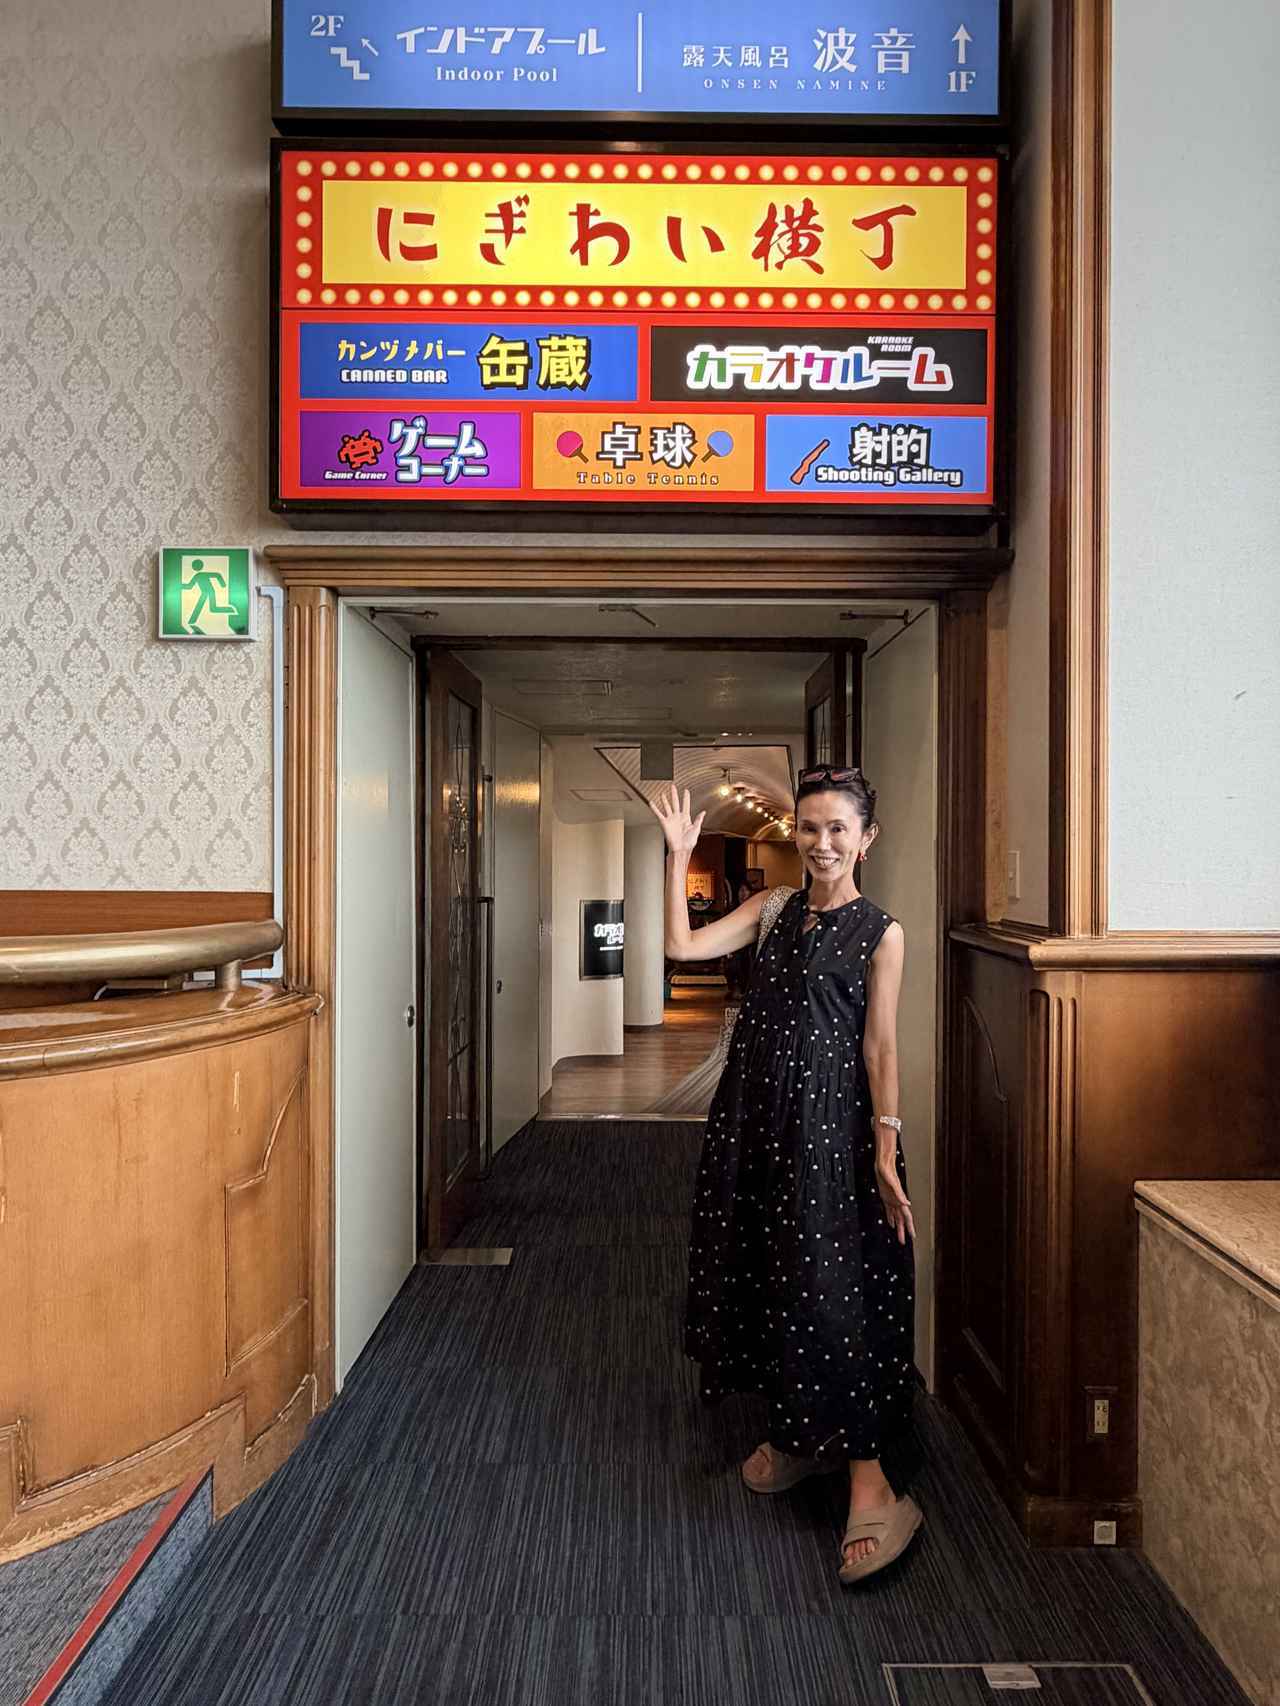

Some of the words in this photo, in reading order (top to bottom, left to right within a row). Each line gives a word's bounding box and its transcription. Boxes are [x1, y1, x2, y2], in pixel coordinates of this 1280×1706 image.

[310, 15, 344, 37] 2F
[396, 26, 606, 55] インドアプール
[682, 44, 790, 68] 露天風呂
[812, 27, 916, 74] 波音
[435, 66, 504, 82] Indoor
[513, 67, 558, 83] Pool
[703, 78, 779, 90] ONSEN
[796, 79, 888, 91] NAMINE
[947, 71, 976, 93] 1F
[376, 194, 917, 275] にぎわい横丁
[867, 335, 914, 345] KARAOKE
[881, 344, 912, 353] ROOM
[478, 333, 592, 390] 缶蔵
[687, 345, 953, 391] カラオケルーム
[340, 368, 408, 383] CANNED
[411, 369, 448, 384] BAR
[389, 416, 487, 457] ゲーム
[597, 421, 697, 469] 卓球
[850, 424, 930, 466] 射的
[324, 470, 353, 480] Game
[354, 471, 388, 480] Corner
[396, 454, 489, 484] コーナー
[577, 471, 636, 485] Table
[647, 473, 720, 486] Tennis
[816, 466, 896, 485] Shooting
[899, 467, 962, 486] Gallery
